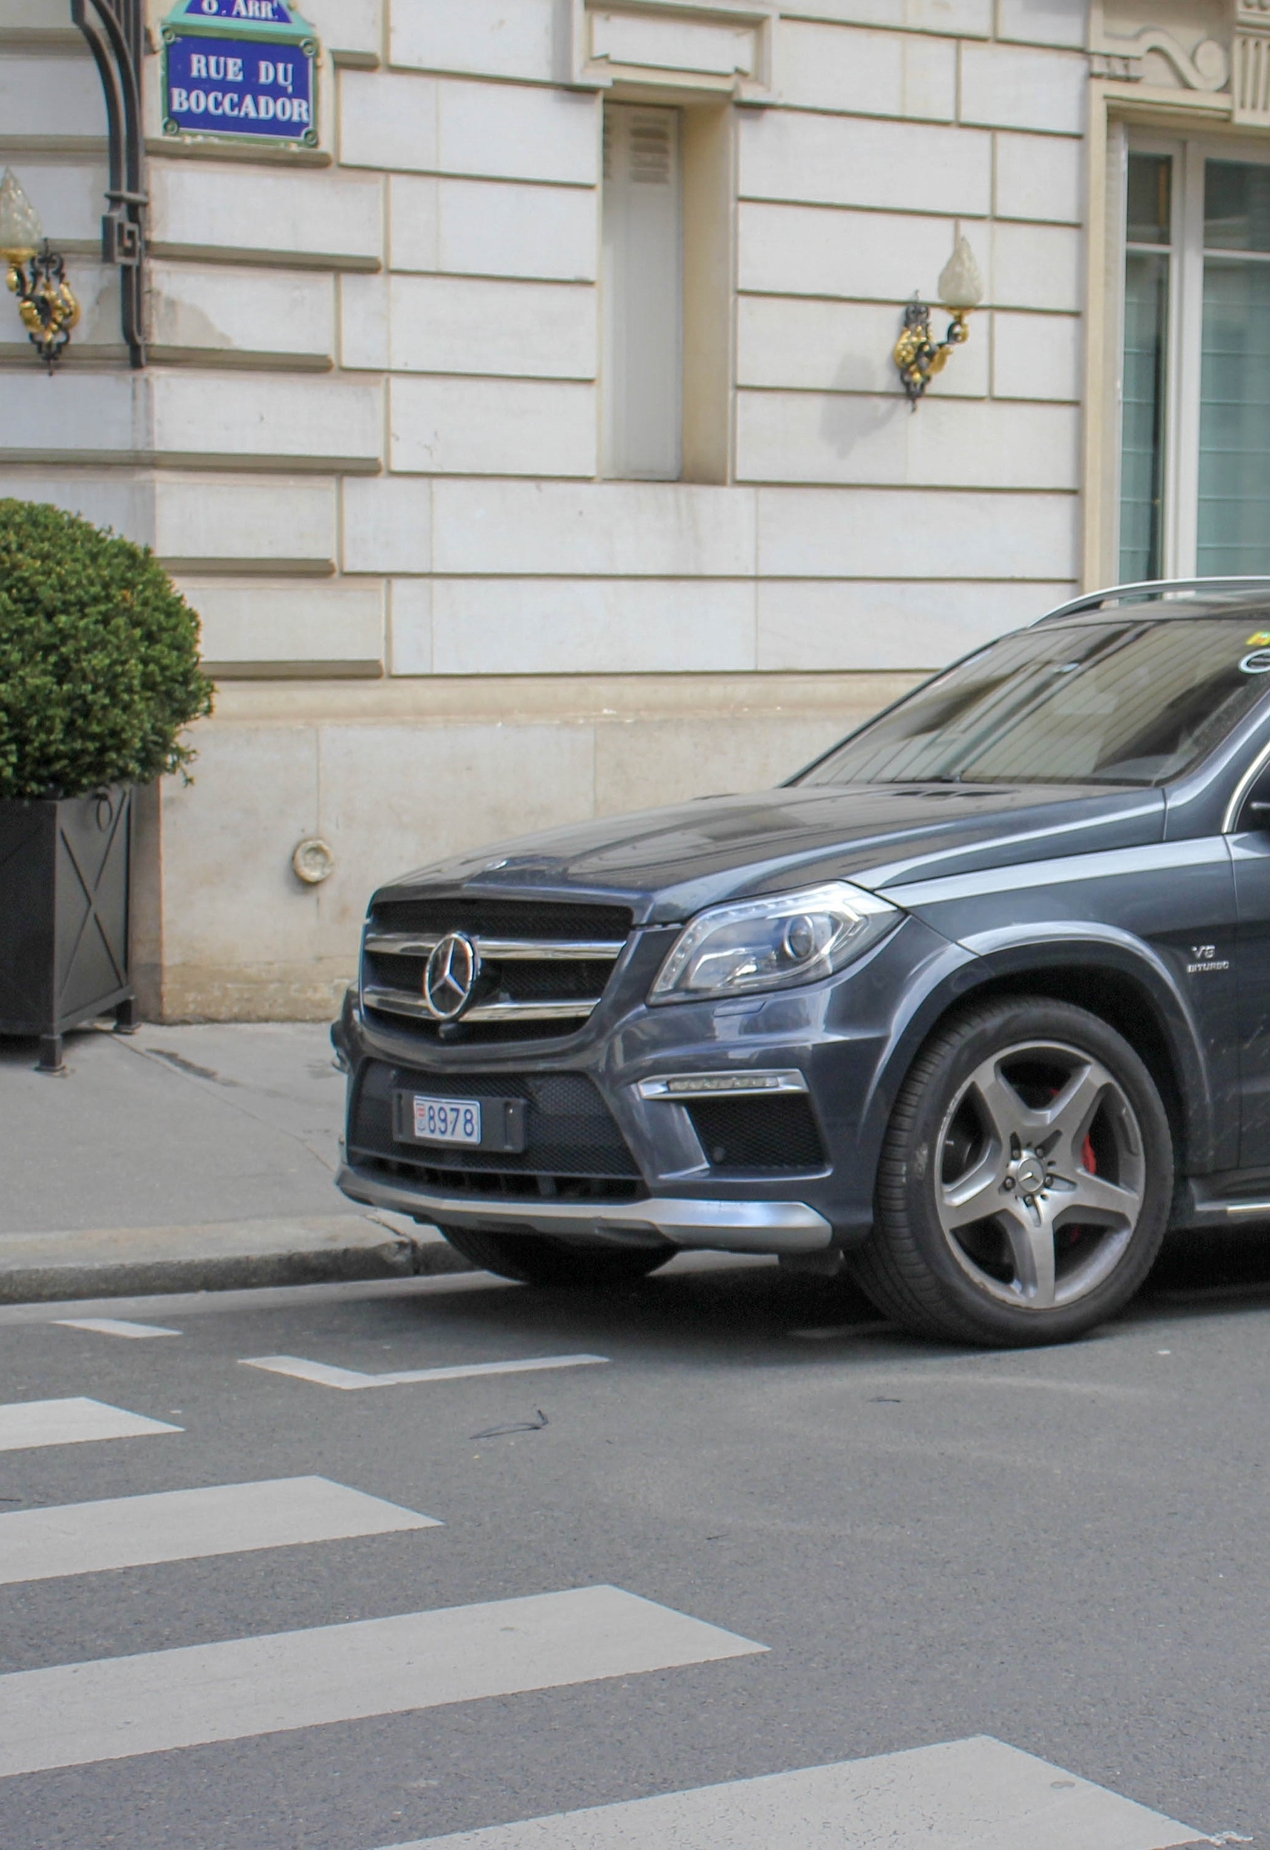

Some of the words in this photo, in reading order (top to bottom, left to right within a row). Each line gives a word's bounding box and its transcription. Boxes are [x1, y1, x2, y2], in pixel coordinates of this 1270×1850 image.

[190, 53, 243, 82] RUE
[258, 60, 293, 90] DU
[171, 87, 310, 124] BOCCADOR
[427, 1105, 475, 1137] 8978
